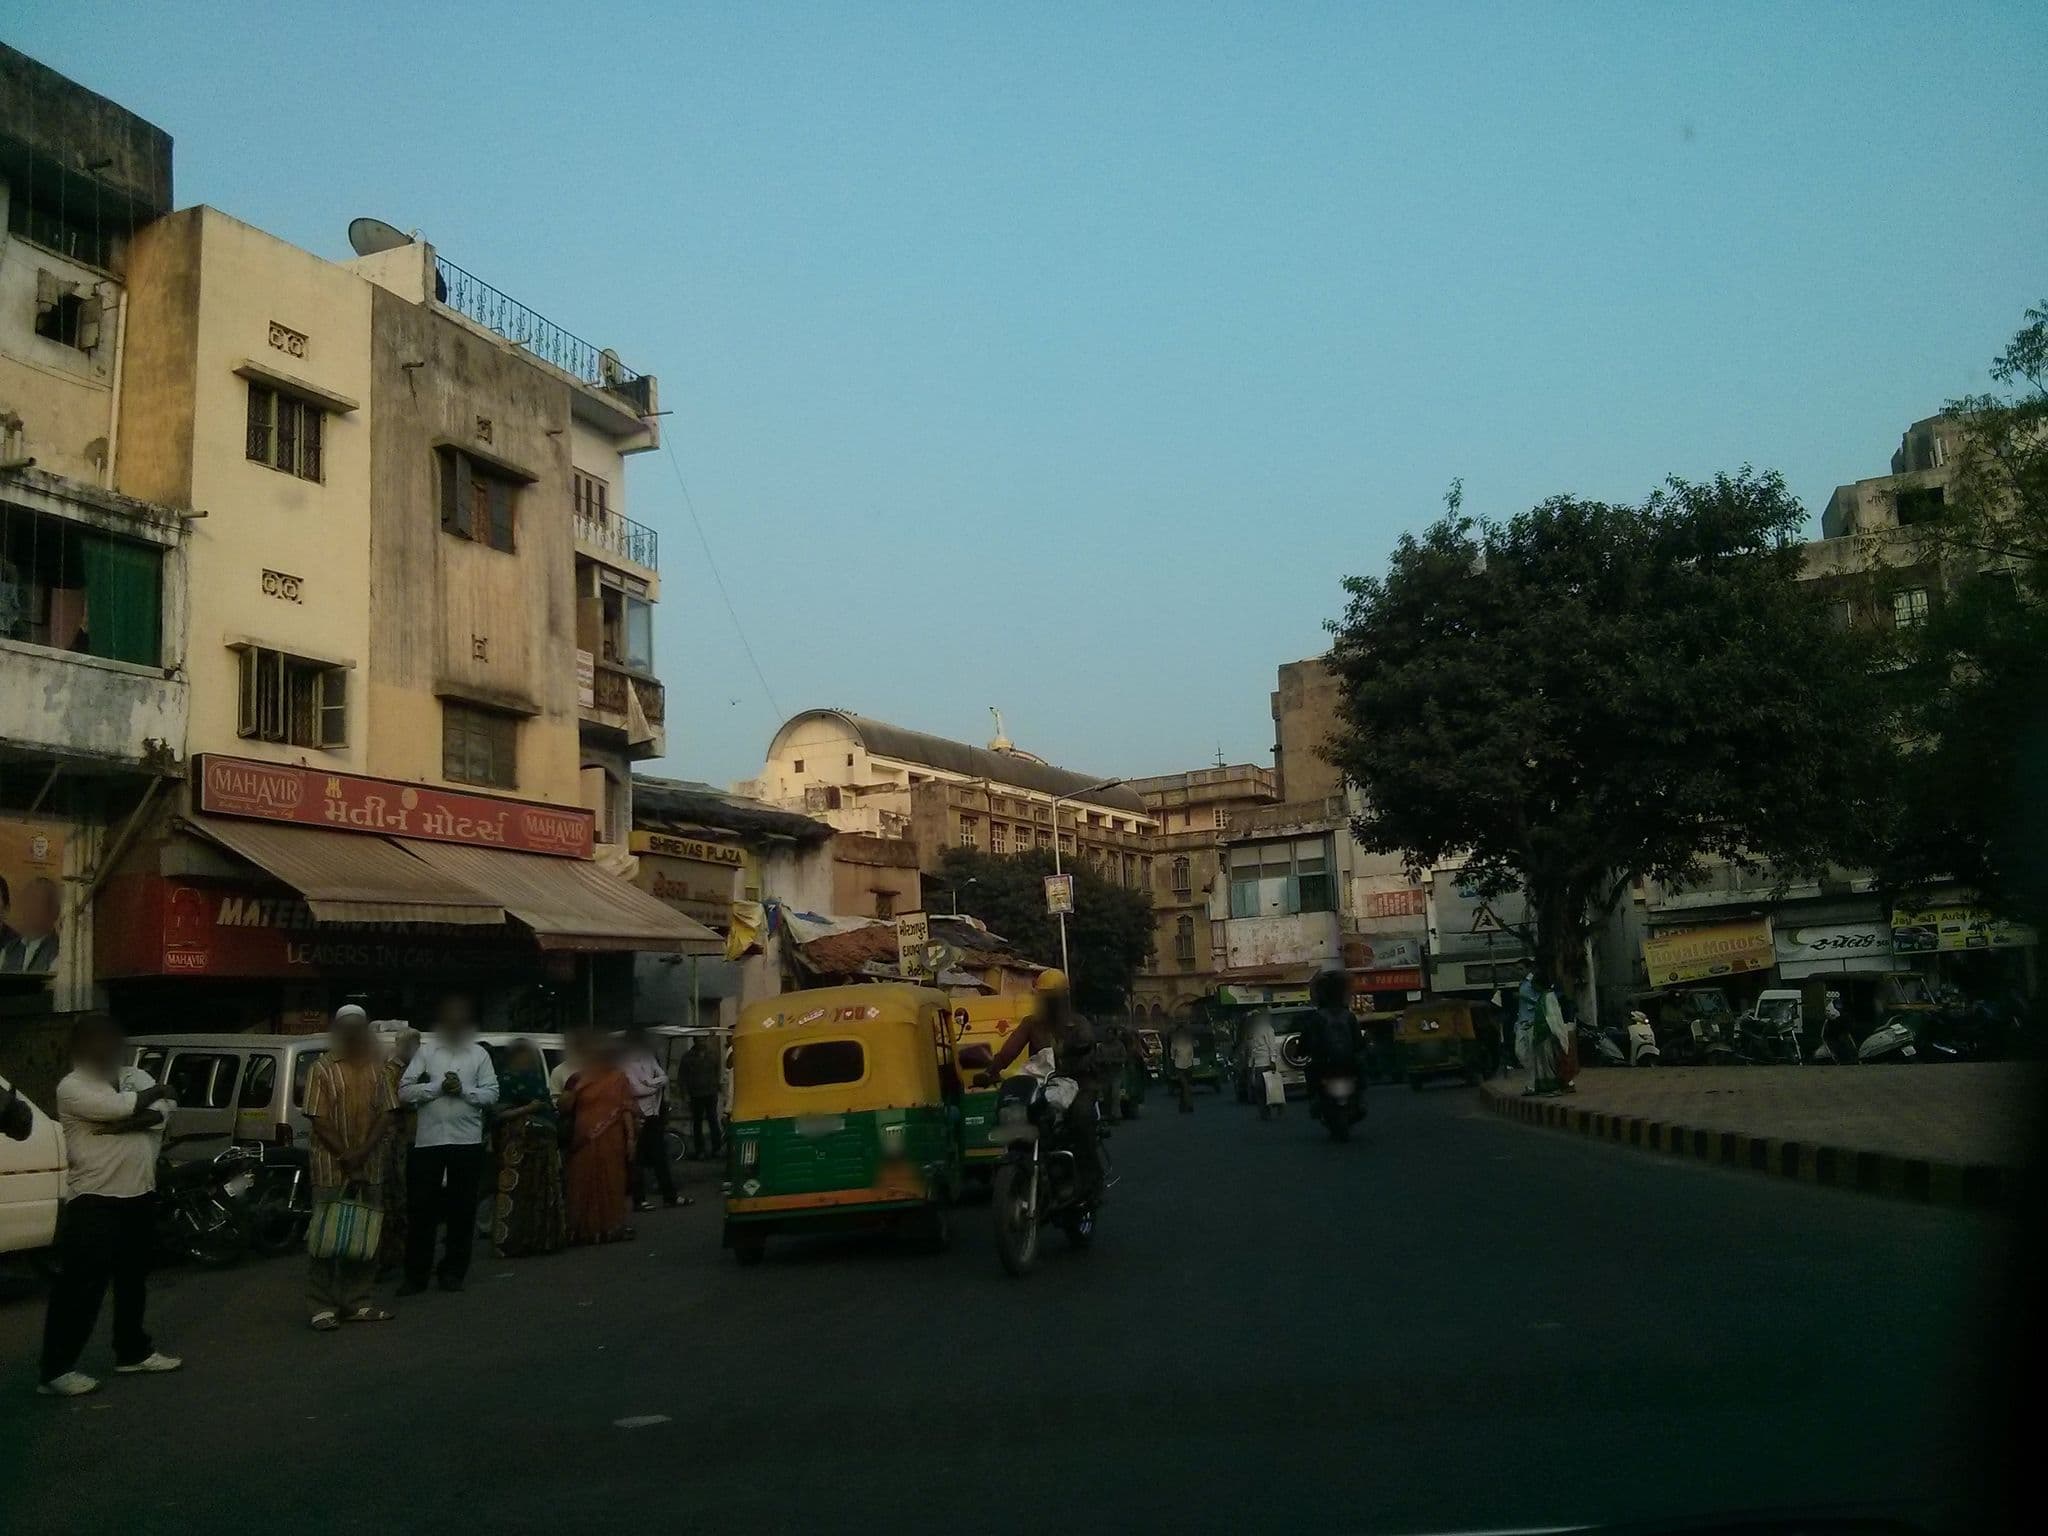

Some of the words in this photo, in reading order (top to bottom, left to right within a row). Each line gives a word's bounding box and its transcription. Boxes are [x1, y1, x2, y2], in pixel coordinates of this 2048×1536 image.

[214, 767, 298, 806] MAHAVIR
[422, 804, 510, 842] મોટર્સ
[525, 813, 587, 846] MAHAVIR
[650, 836, 703, 858] SHREYAS
[706, 845, 742, 864] PLAZA
[215, 895, 314, 929] MATEE
[166, 953, 206, 968] MAHAVIR
